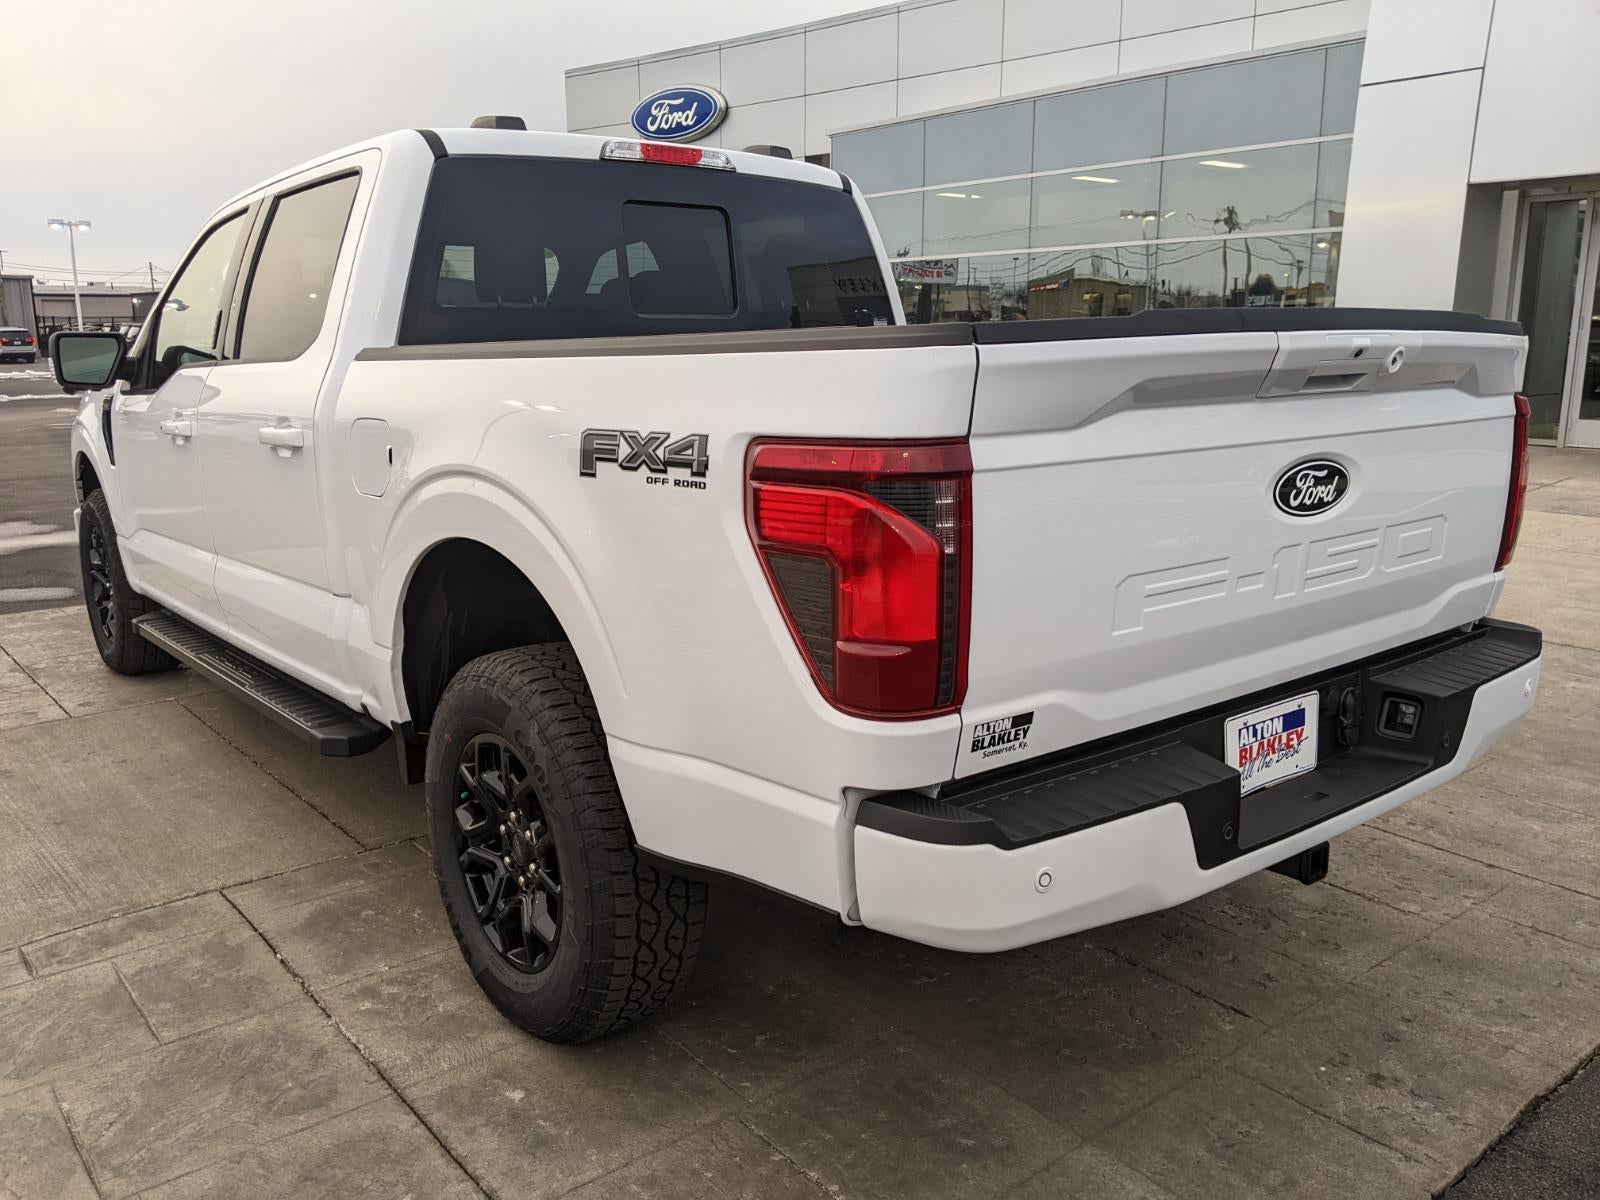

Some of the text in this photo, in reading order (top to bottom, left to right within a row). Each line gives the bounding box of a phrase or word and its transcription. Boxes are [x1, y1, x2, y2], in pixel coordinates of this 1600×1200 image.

[647, 97, 698, 132] Ford
[579, 428, 709, 478] FX4
[646, 476, 707, 490] OFF ROAD
[1289, 468, 1337, 507] Ford
[1111, 514, 1448, 636] F-150
[971, 725, 1031, 753] BLAKLEY
[974, 717, 1013, 738] ALTON
[1239, 716, 1284, 748] ALTON
[1239, 727, 1305, 768] BLAKLEY
[1257, 749, 1275, 773] The
[1276, 736, 1309, 763] Best
